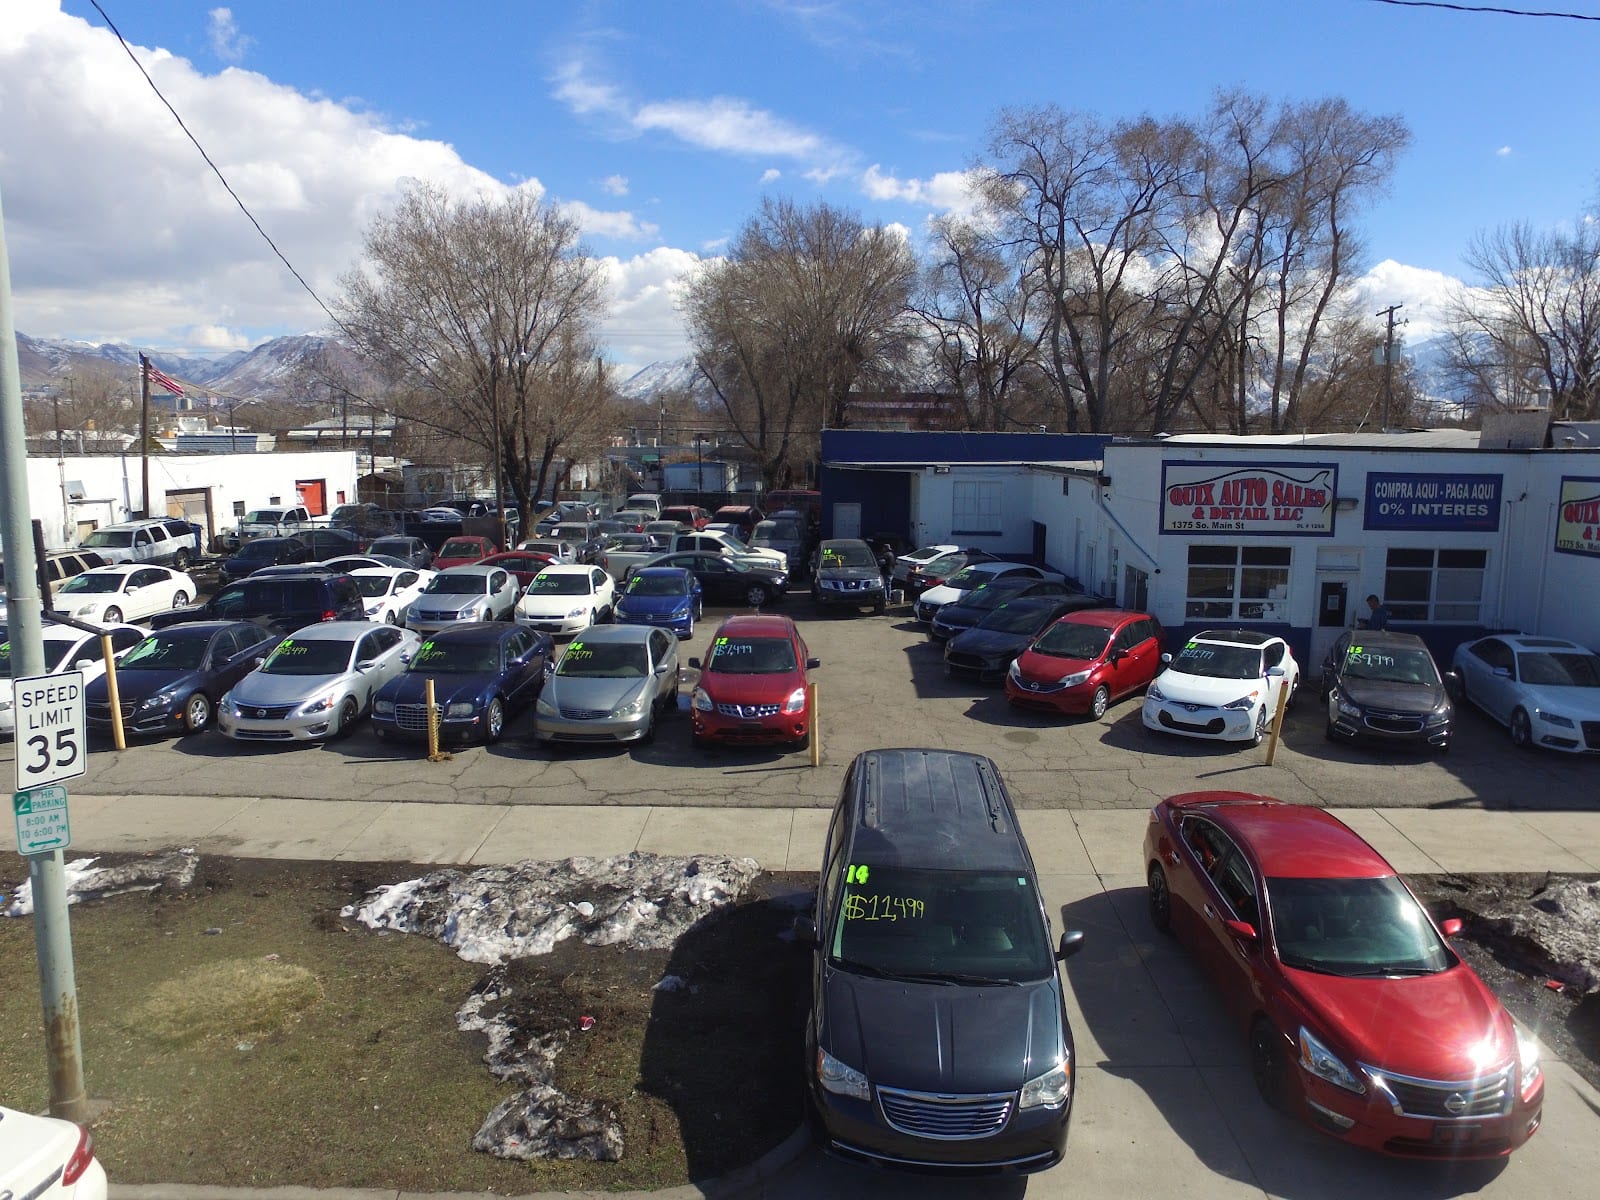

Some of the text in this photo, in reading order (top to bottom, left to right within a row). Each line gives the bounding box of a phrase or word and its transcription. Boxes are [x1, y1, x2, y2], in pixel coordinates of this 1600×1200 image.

[1169, 477, 1326, 508] QUIX AUTO SALES
[1374, 482, 1413, 499] COMPRA
[1415, 483, 1438, 499] AQUI
[1445, 483, 1469, 499] PAGA
[1471, 484, 1495, 500] AQUI
[1192, 507, 1304, 521] & DETAIL LLC
[1379, 503, 1489, 516] 0% INTERES
[1172, 521, 1245, 530] 1375 So. Main St
[715, 637, 728, 645] 12
[1350, 646, 1363, 654] 15
[21, 684, 79, 708] SPEED
[29, 707, 72, 730] LIMIT
[25, 727, 78, 774] 35
[17, 790, 54, 812] 2 HR
[32, 797, 65, 810] PARKING
[26, 814, 60, 827] 8:00 AM
[20, 824, 67, 839] TO 6:00 PM
[846, 864, 870, 884] 14
[844, 893, 925, 922] $11,499
